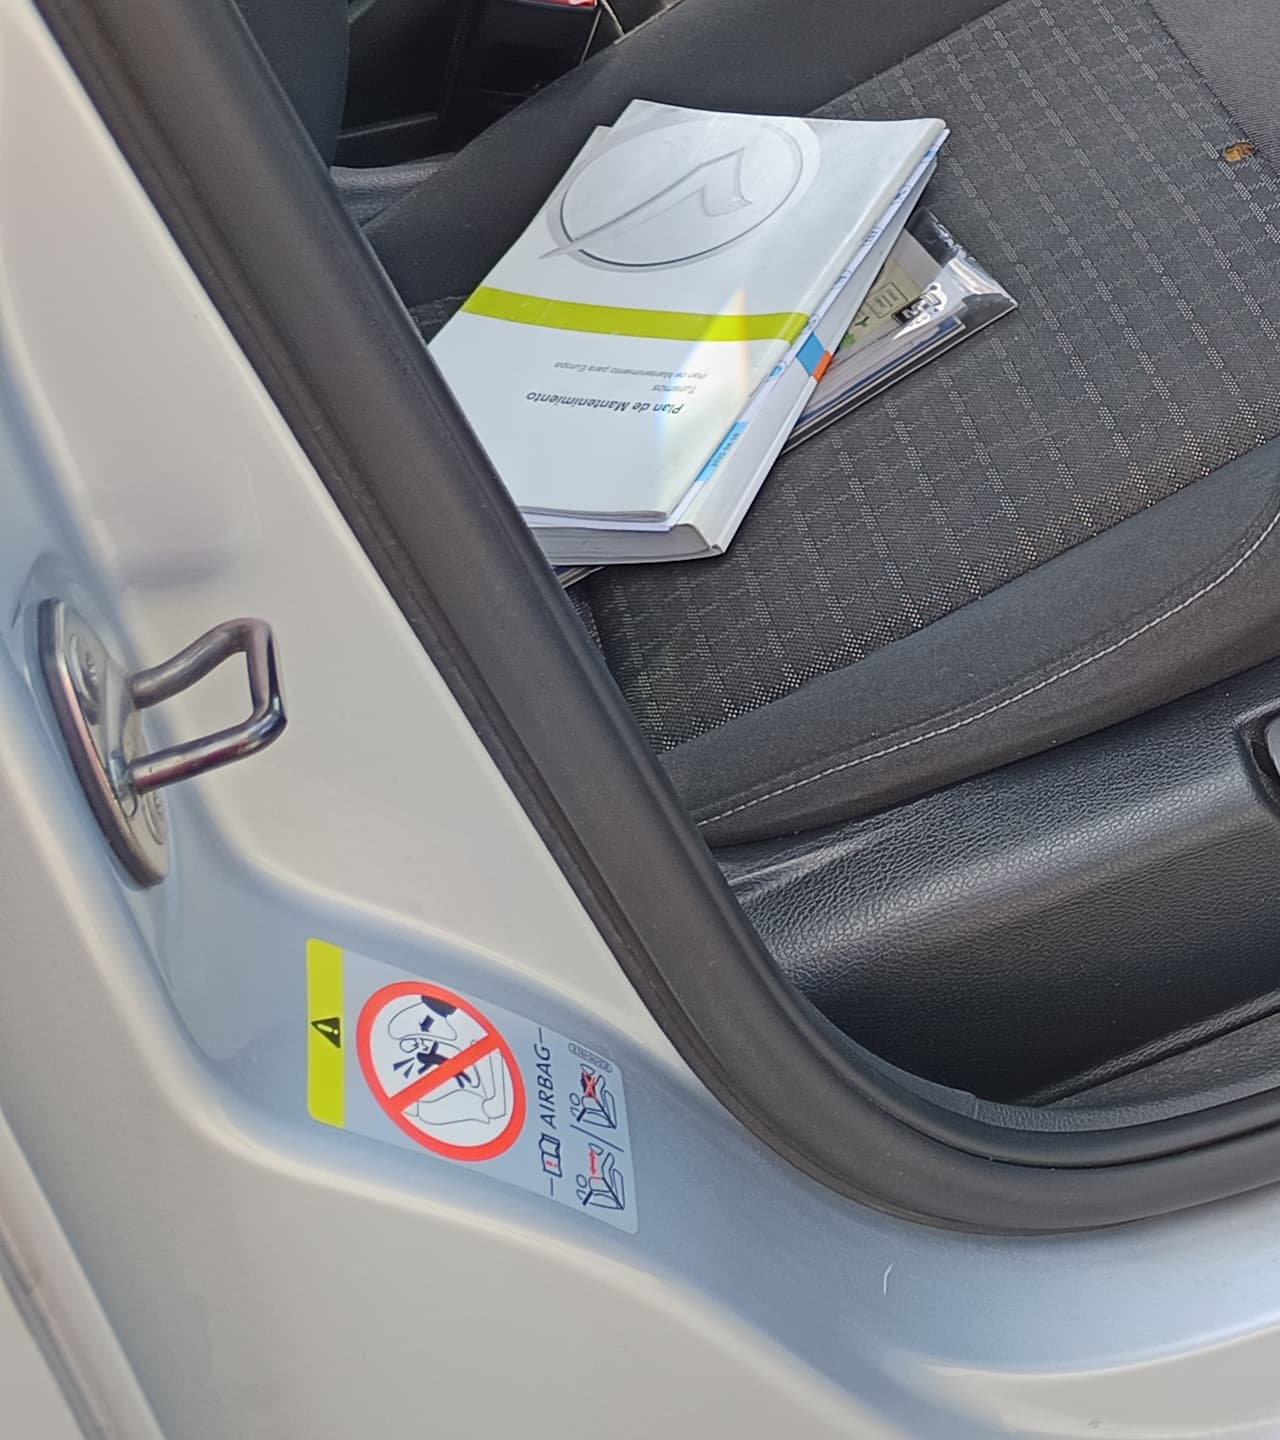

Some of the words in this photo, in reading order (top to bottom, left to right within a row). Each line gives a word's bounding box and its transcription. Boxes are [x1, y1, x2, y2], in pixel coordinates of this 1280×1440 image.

[553, 361, 588, 373] Europa
[588, 363, 610, 373] para
[610, 367, 673, 378] Mantenimiento
[525, 391, 630, 412] Mantenimiento
[633, 401, 650, 413] de
[653, 402, 684, 414] Plan
[534, 1043, 556, 1129] AIRBAG
